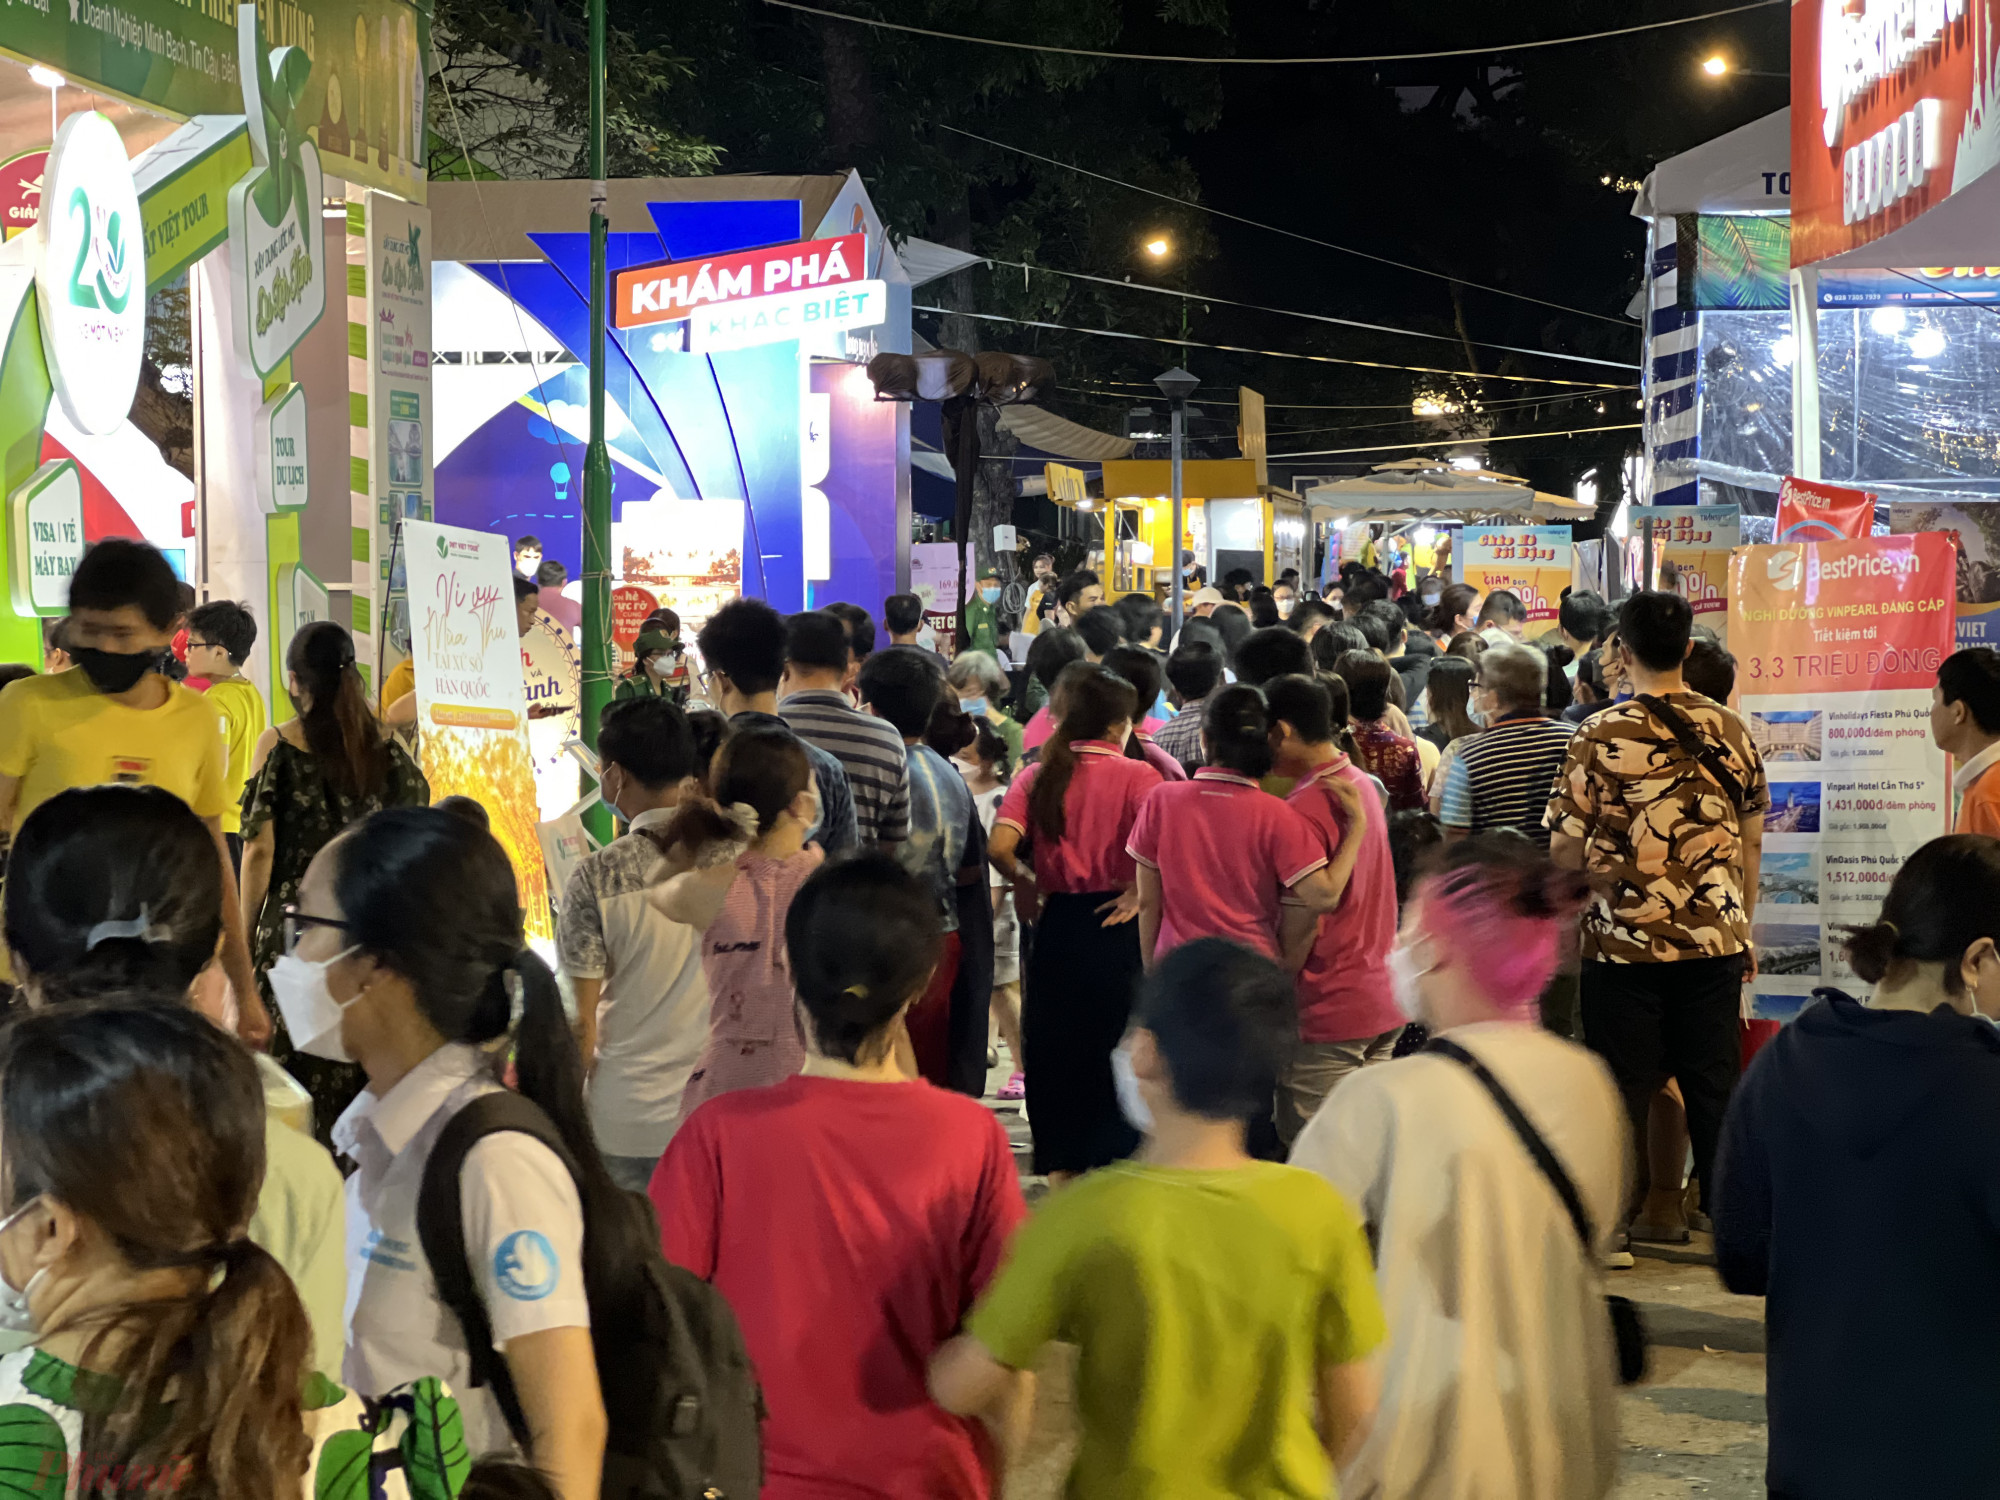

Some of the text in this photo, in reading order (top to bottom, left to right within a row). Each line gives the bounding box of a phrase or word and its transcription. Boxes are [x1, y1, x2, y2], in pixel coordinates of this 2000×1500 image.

[83, 0, 112, 33] Doanh
[113, 7, 143, 53] Nghiệp
[144, 20, 165, 55] Minh
[157, 209, 183, 249] VIỆT
[182, 193, 209, 231] TOUR
[631, 241, 850, 314] KHÁM PHÁ
[802, 290, 870, 324] BIỆT
[275, 437, 296, 457] TOUR
[276, 466, 305, 490] DU LỊCH
[1792, 487, 1831, 510] BestPrice.vn
[33, 517, 76, 543] VISA VÉ
[1478, 534, 1537, 547] Chào Hè
[34, 550, 77, 576] MÁY BAY
[1517, 547, 1555, 561] Động
[1809, 553, 1920, 582] BestPrice.vn
[436, 571, 466, 618] Vi
[1826, 603, 1879, 620] VINPEARL
[1813, 626, 1878, 643] Tiết kiệm tới
[530, 668, 543, 678] VÀ
[1793, 649, 1860, 681] TRIỆU
[1866, 642, 1942, 675] ĐỒNG
[434, 674, 491, 700] HÀN QUỐC
[1828, 711, 1869, 721] Vinholidays
[1869, 709, 1893, 720] Fiesta
[1826, 782, 1856, 792] Vinpearl
[1857, 781, 1879, 790] Hotel
[1898, 780, 1915, 790] Thơ
[1826, 855, 1860, 864] VinOasis
